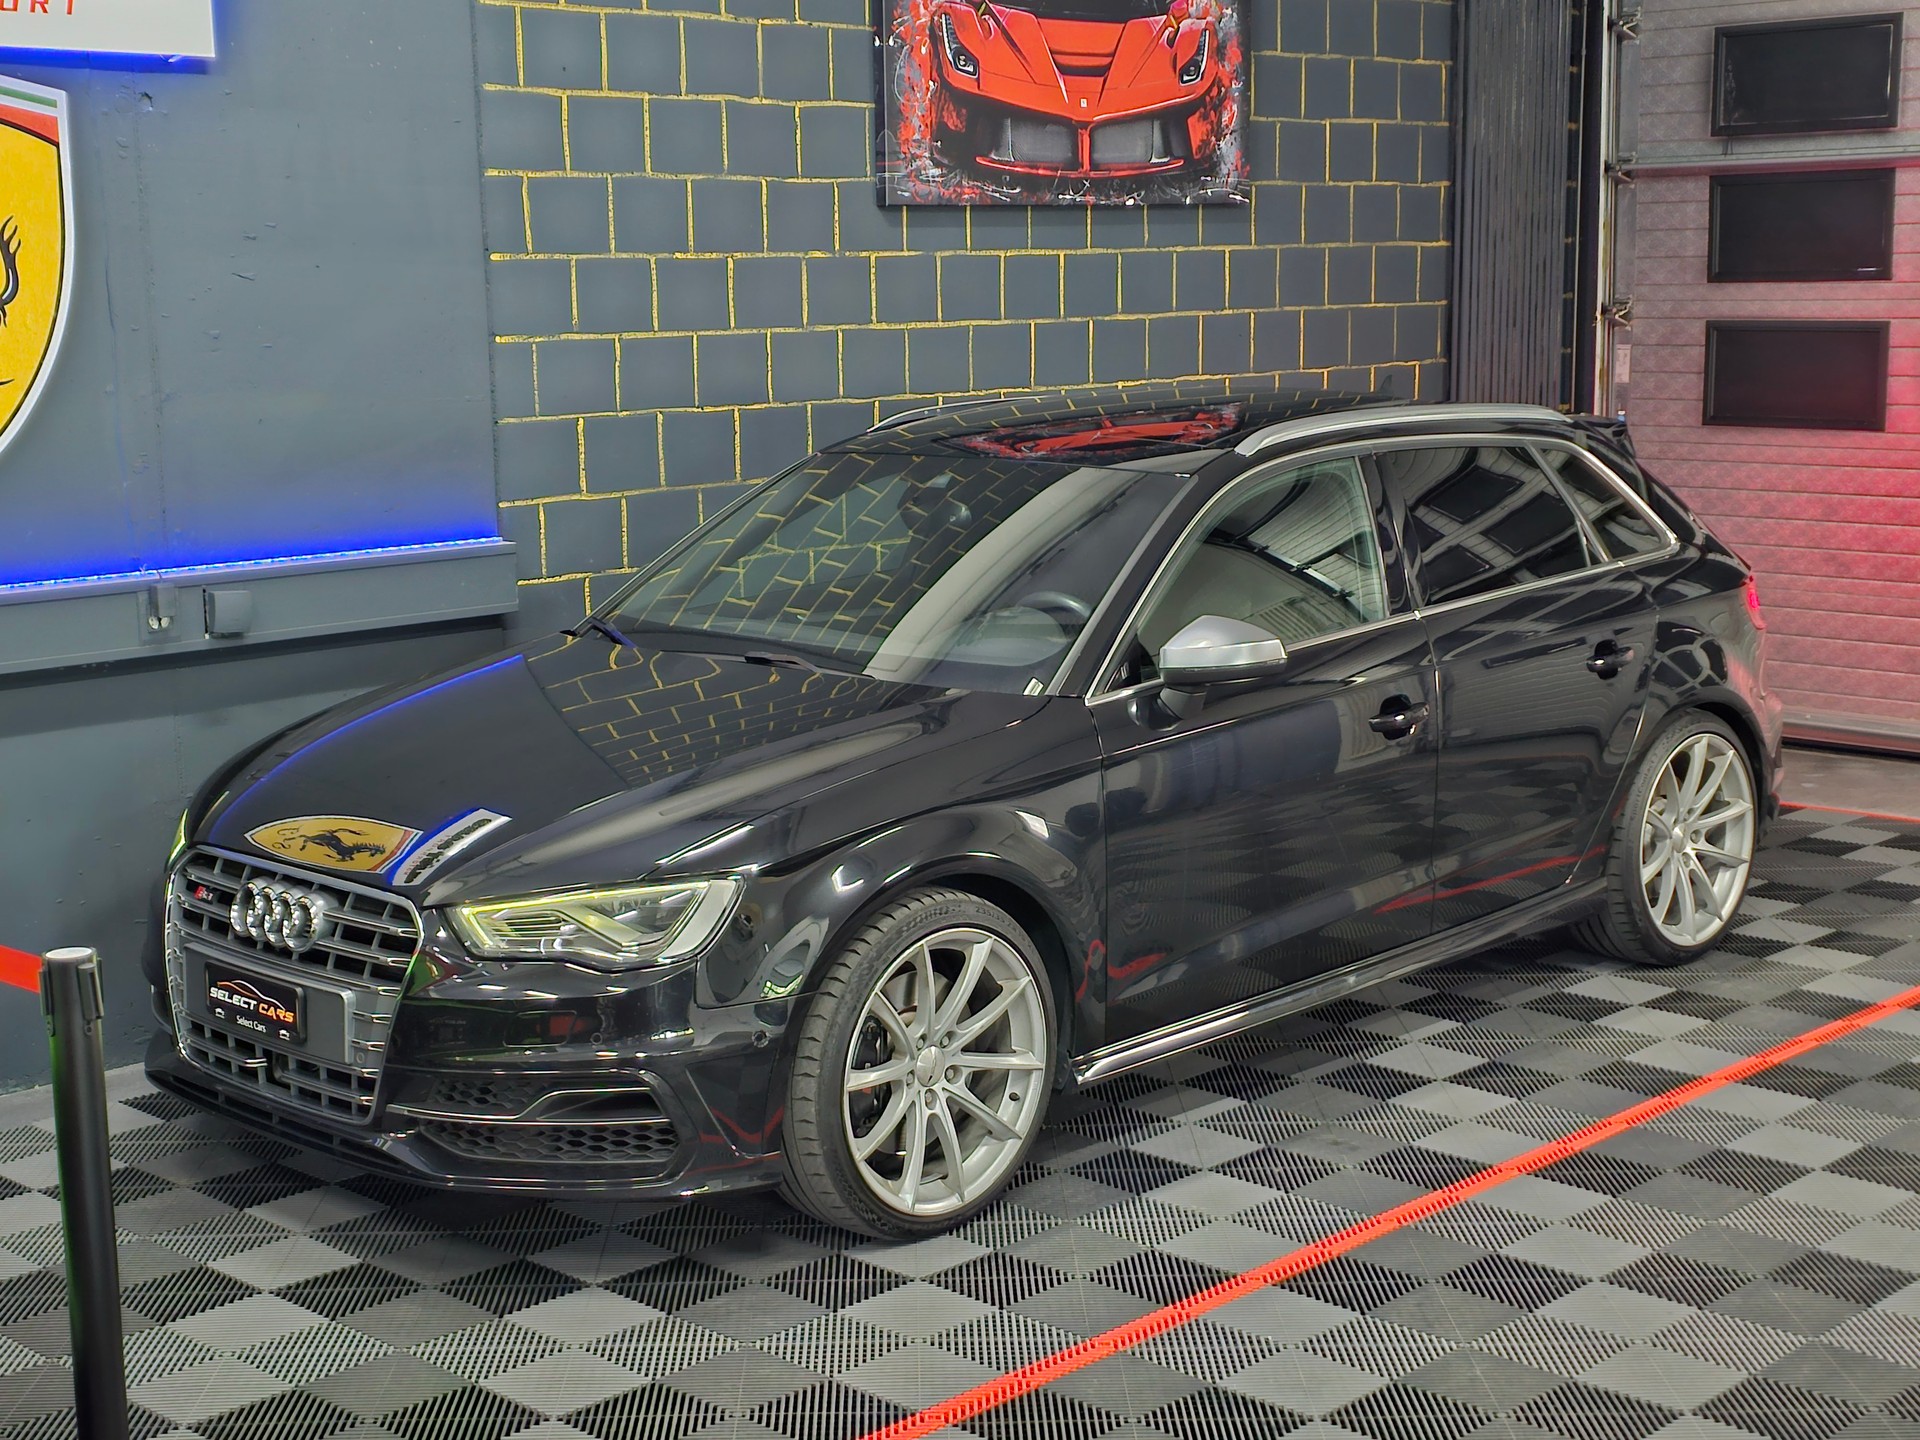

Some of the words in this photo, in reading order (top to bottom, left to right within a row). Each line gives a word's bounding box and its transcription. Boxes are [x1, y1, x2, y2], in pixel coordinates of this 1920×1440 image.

[209, 987, 258, 1010] SELECT
[258, 1002, 295, 1023] CARS
[236, 1015, 253, 1029] Select
[253, 1021, 267, 1033] Cars
